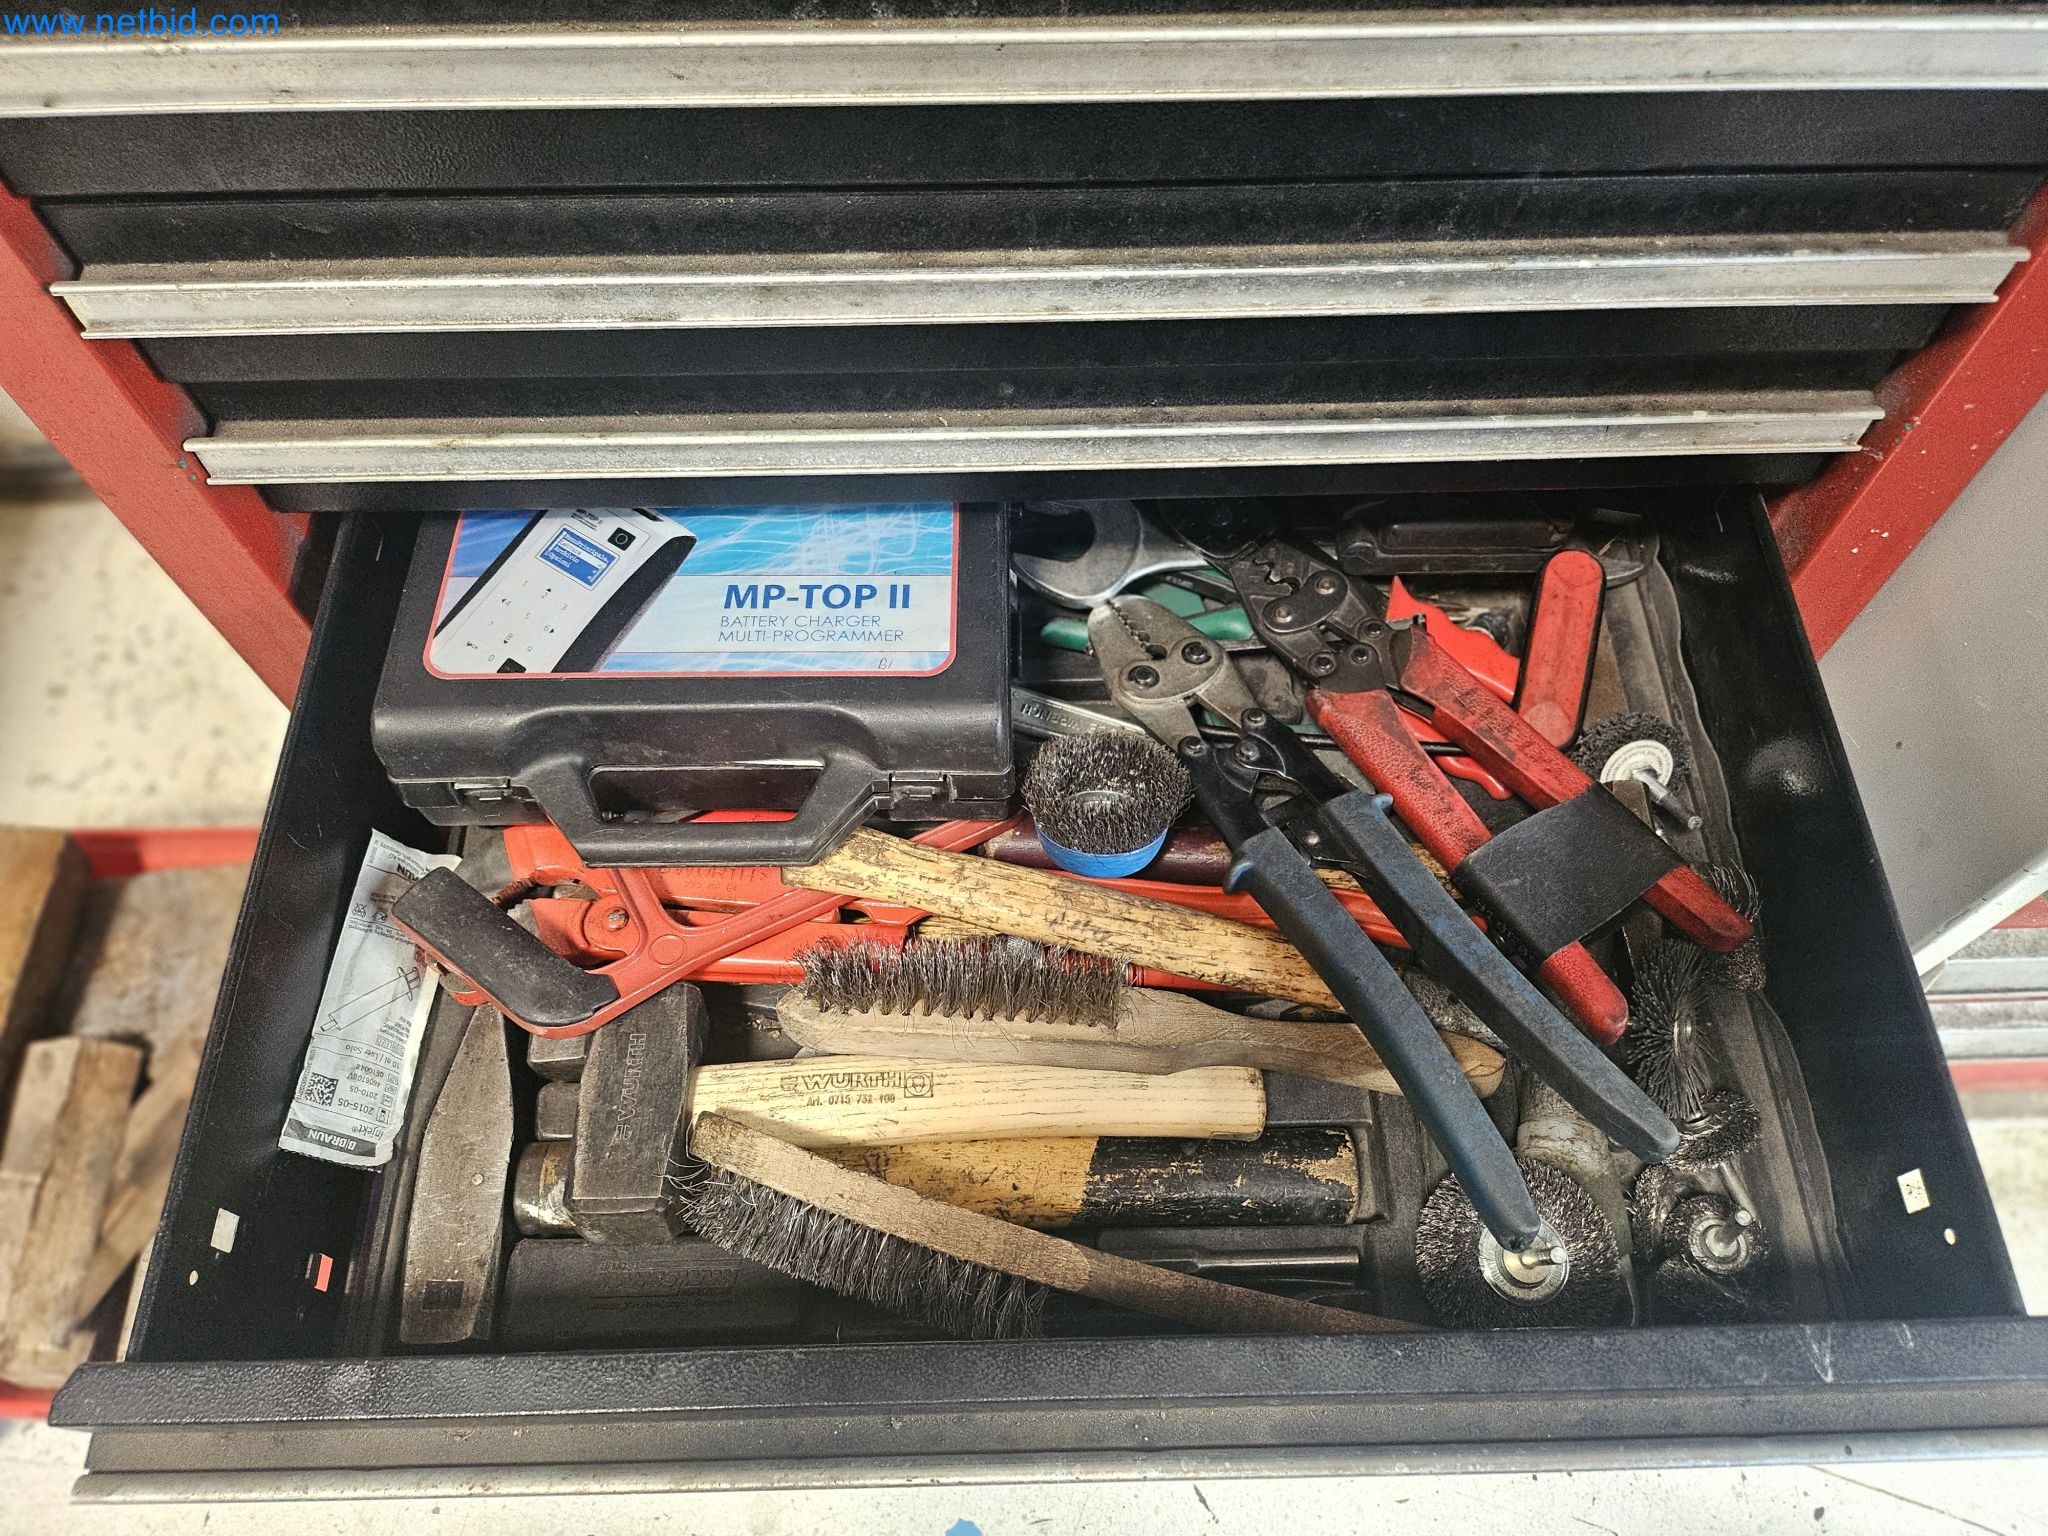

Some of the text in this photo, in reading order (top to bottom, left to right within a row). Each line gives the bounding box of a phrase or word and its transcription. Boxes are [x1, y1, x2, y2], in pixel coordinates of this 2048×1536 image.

[723, 583, 911, 609] MP-TOP II
[720, 614, 881, 628] BATTERY CHARGER
[718, 629, 904, 642] MULTI-PROGRAMMER
[364, 1049, 379, 1059] Luer
[349, 1086, 378, 1099] 2010-05
[337, 1098, 374, 1115] 2015-05
[828, 1094, 851, 1106] 0715
